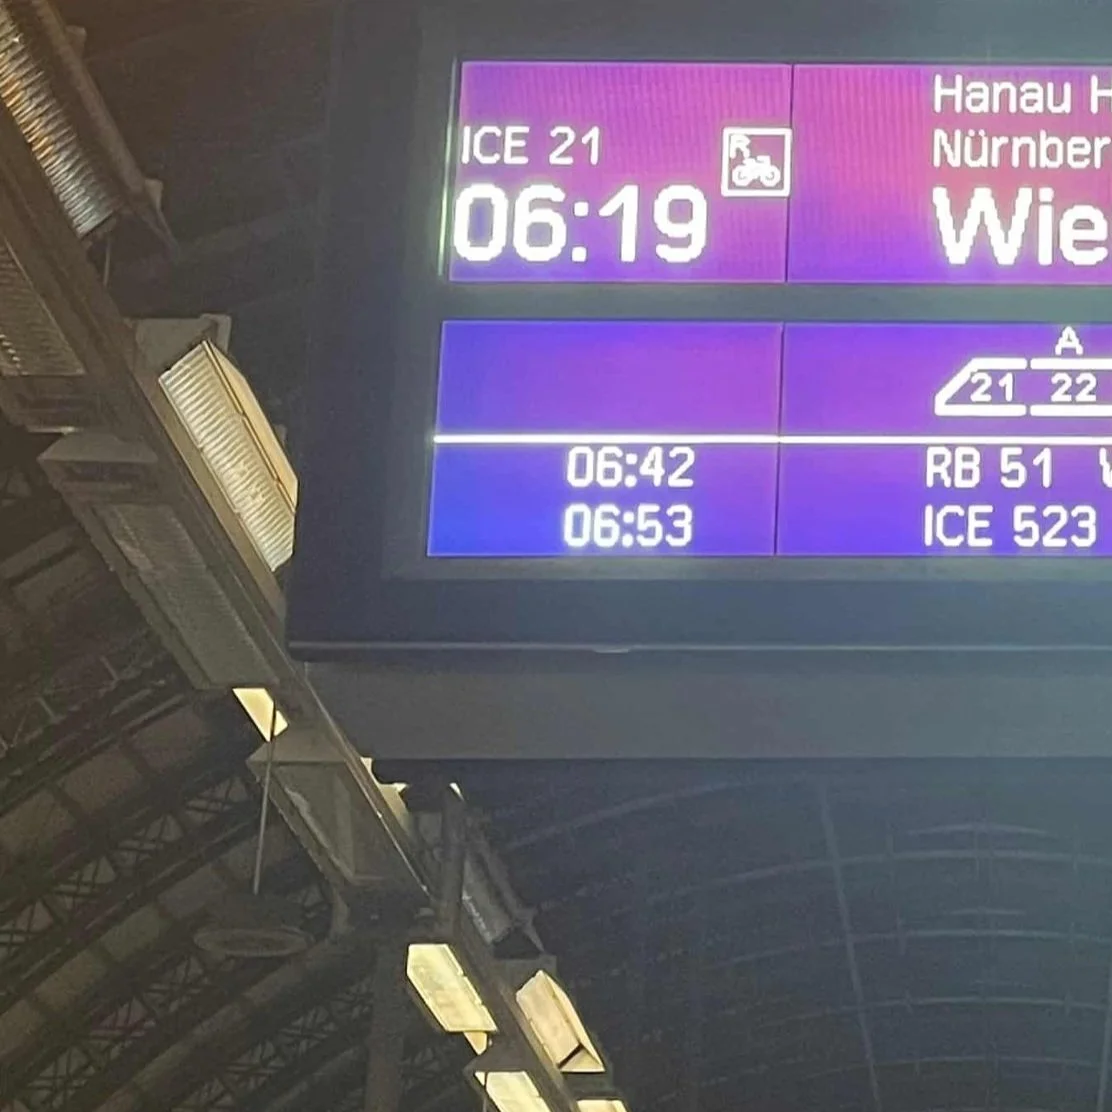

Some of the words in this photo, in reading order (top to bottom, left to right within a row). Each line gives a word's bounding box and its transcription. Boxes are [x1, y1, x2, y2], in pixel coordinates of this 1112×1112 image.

[934, 75, 1071, 114] Hanau
[461, 126, 529, 165] ICE
[549, 126, 602, 166] 21
[453, 184, 708, 264] 06:19
[1055, 326, 1083, 354] A
[970, 373, 1014, 402] 21
[1051, 373, 1097, 403] 22
[566, 446, 695, 488] 06:42
[925, 446, 981, 488] RB
[1001, 447, 1054, 489] 51
[563, 504, 693, 547] 06:53
[924, 505, 993, 548] ICE
[1013, 505, 1097, 548] 523
